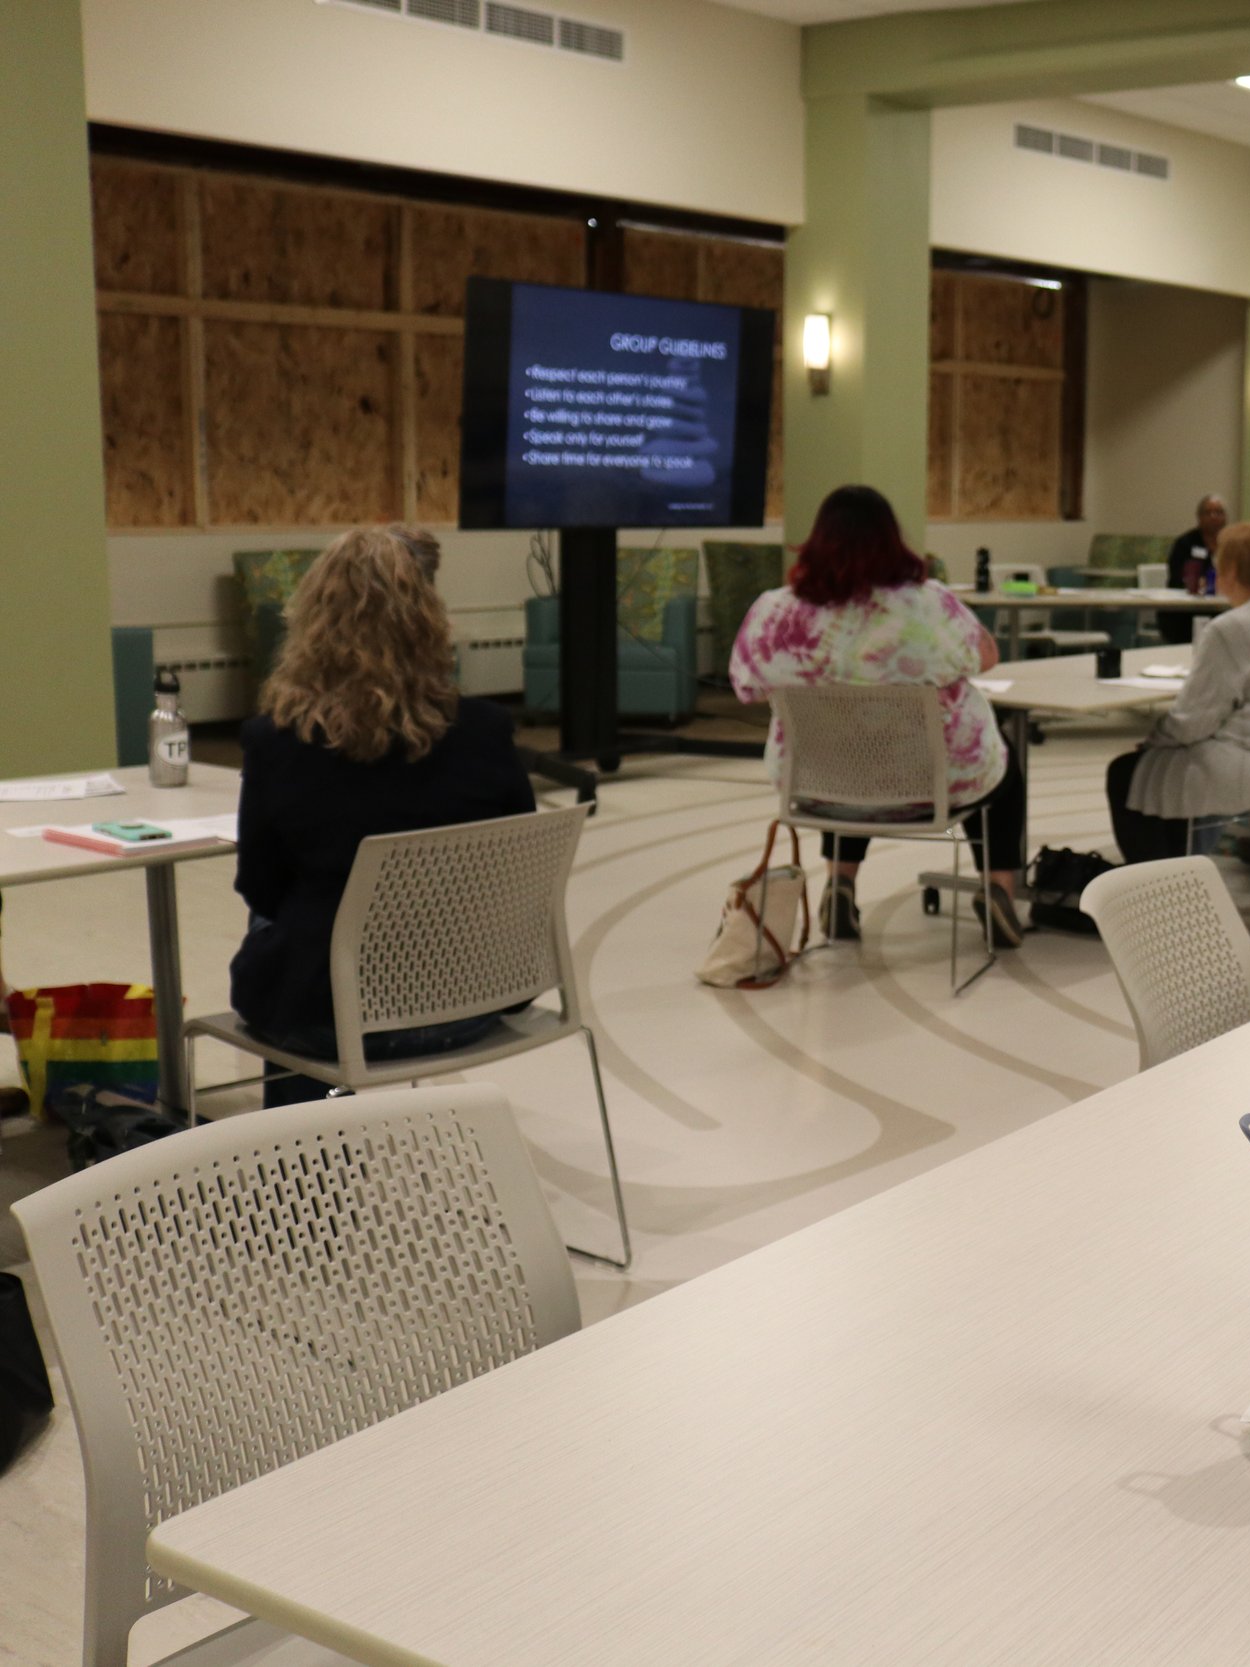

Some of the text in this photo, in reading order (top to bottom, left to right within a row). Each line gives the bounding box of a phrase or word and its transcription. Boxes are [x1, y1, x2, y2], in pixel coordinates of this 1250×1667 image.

[610, 332, 728, 360] GROUP GUIDELINES
[530, 364, 577, 383] Respect
[577, 370, 605, 384] each
[563, 388, 574, 403] to
[576, 390, 604, 404] each
[547, 408, 579, 427] willing
[580, 410, 592, 424] to
[593, 411, 622, 426] share
[624, 413, 645, 427] and
[529, 428, 563, 445] Speak
[589, 430, 604, 445] for
[528, 450, 559, 466] Share
[586, 452, 602, 467] for
